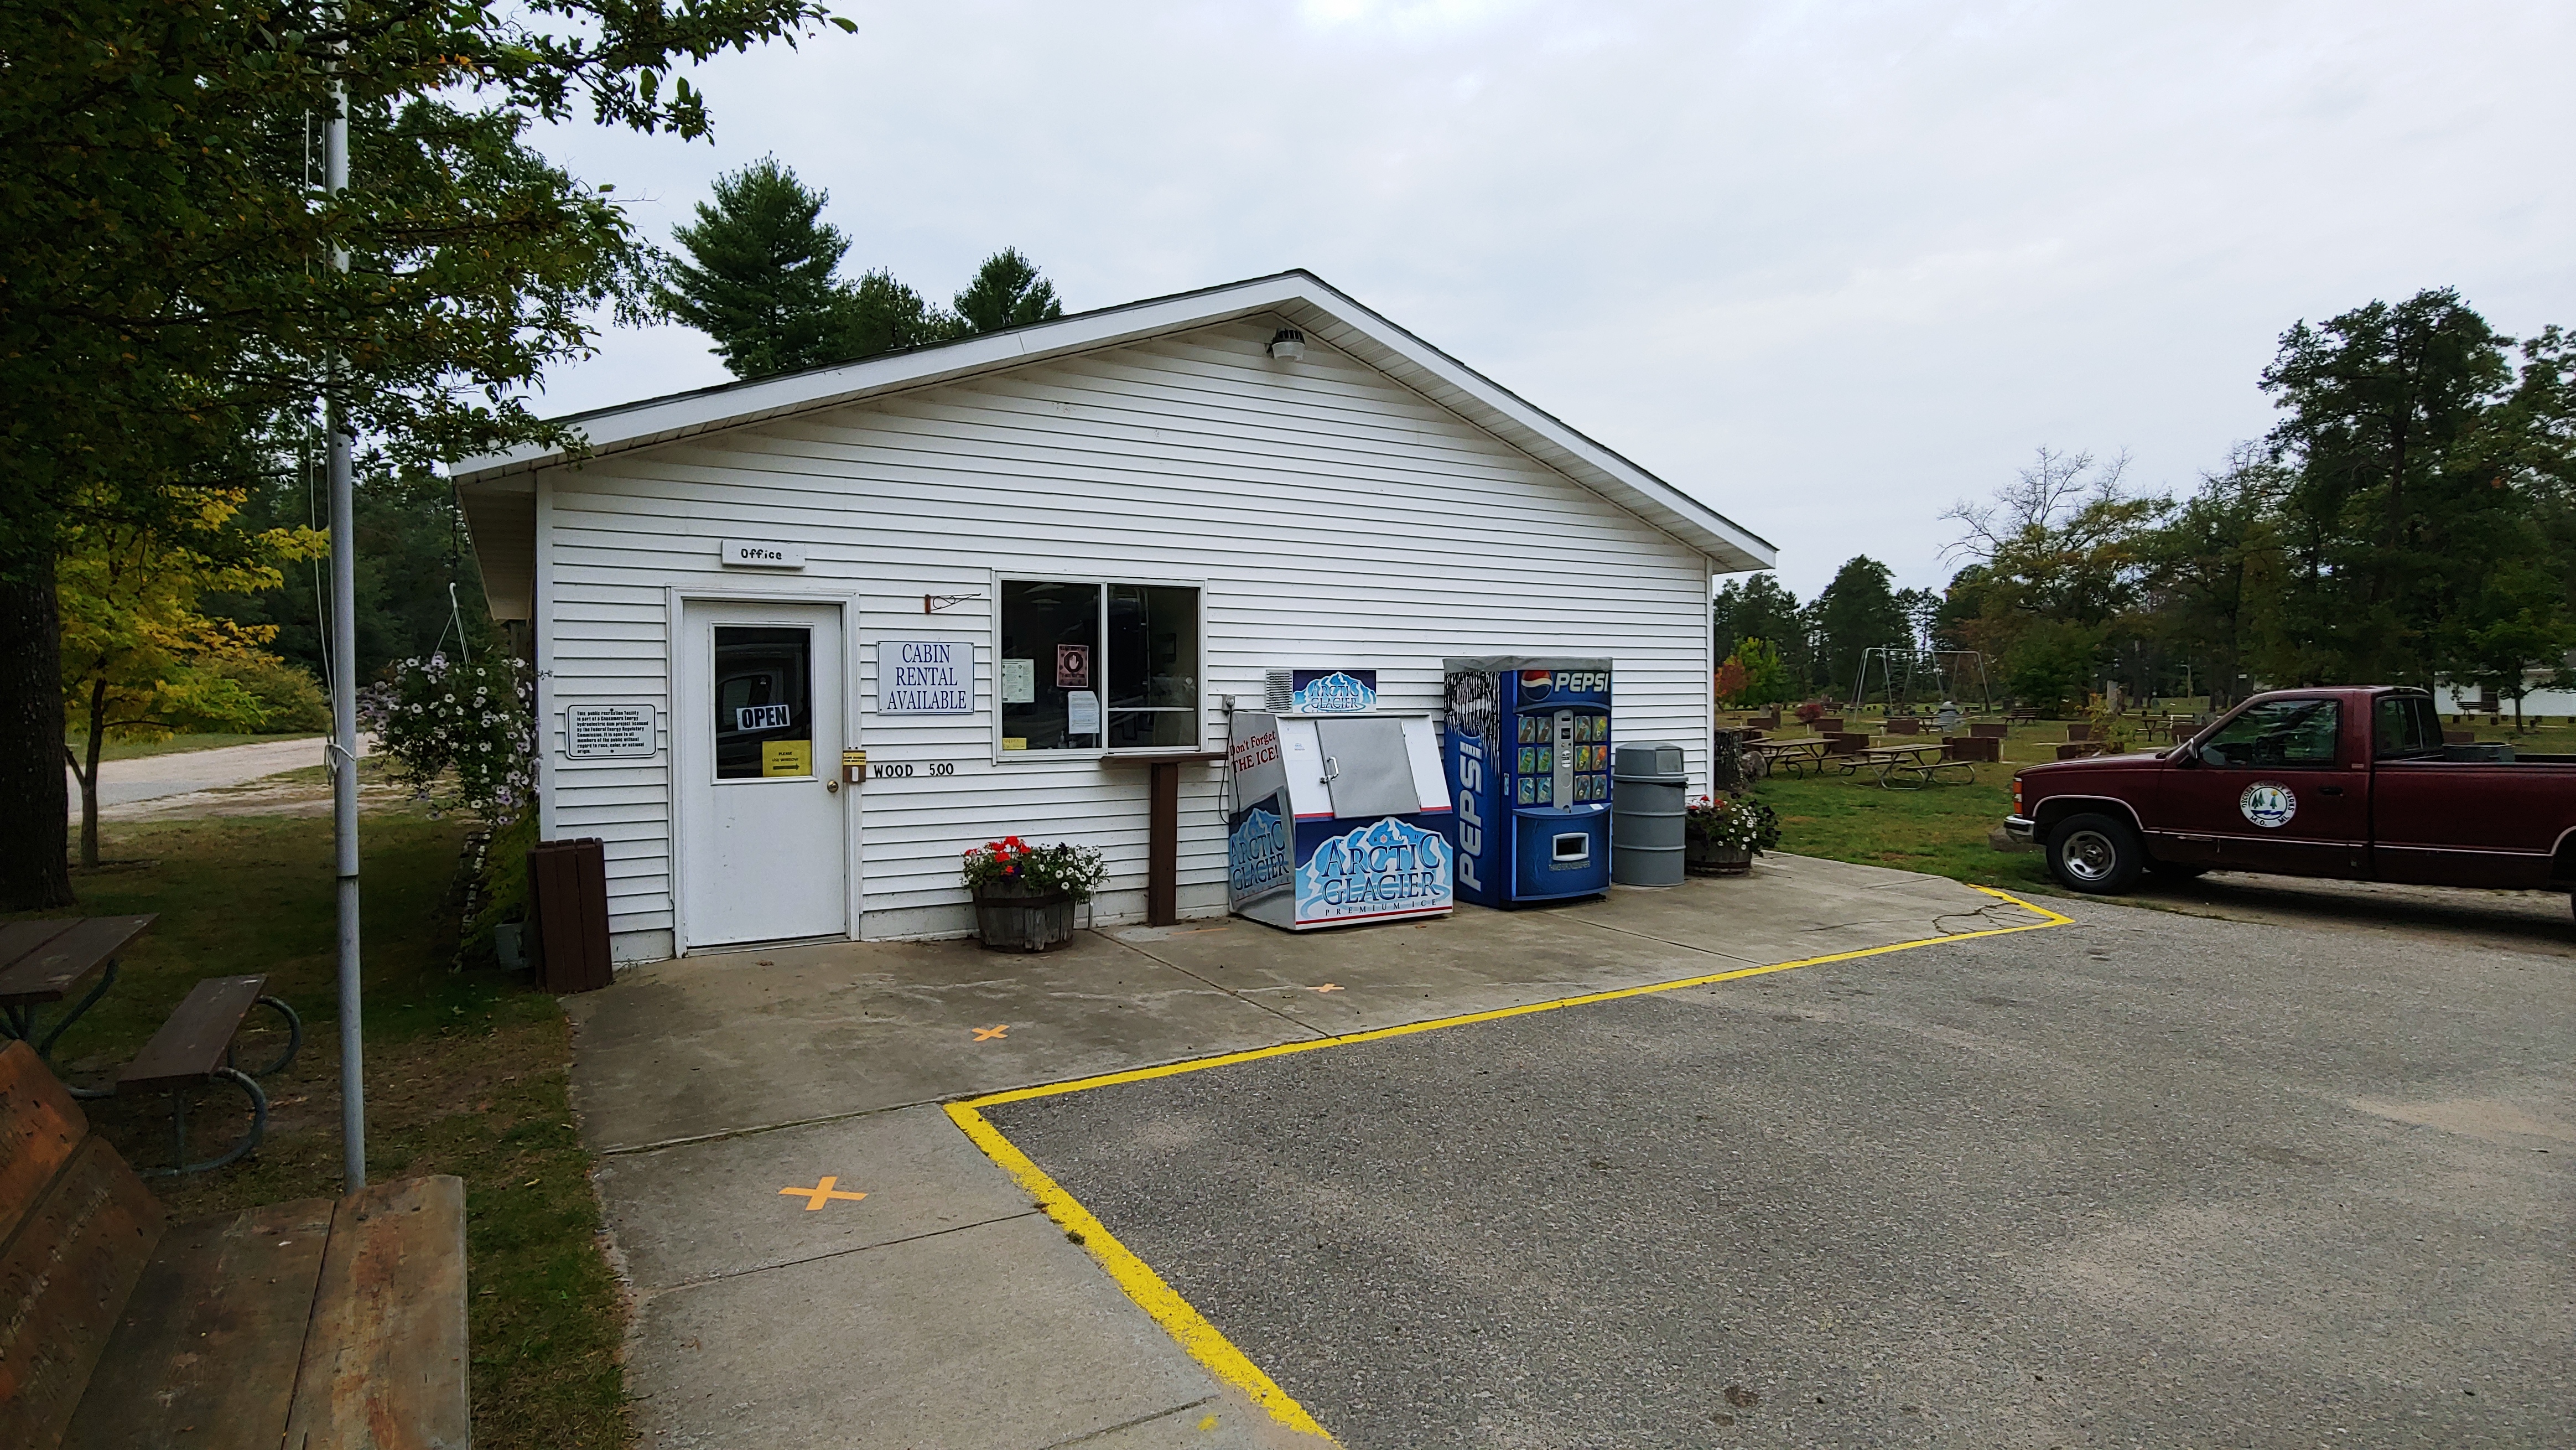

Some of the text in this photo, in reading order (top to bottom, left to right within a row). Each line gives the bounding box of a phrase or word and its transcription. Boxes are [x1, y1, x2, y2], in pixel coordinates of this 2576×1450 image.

[741, 548, 782, 560] Office
[902, 644, 951, 663] CABIN
[895, 667, 958, 686] RENTAL
[1554, 672, 1609, 692] PEPSI
[1310, 682, 1359, 697] ARCTIC
[886, 690, 967, 710] AVAILABLE
[1311, 697, 1359, 708] GLACIER
[741, 706, 787, 728] OPEN
[1229, 739, 1250, 757] Don't
[1250, 730, 1276, 749] Forget
[1231, 754, 1255, 773] THE
[1255, 744, 1279, 766] ICE!
[874, 764, 913, 778] WOOD
[2241, 786, 2256, 808] OSCODA
[1459, 740, 1483, 893] PEPSI
[1230, 820, 1285, 867] ARCTIC
[1339, 833, 1419, 845] CLEAR COLD
[1321, 833, 1440, 877] ARCTIC
[1233, 852, 1290, 891] GLACIER
[1322, 871, 1440, 905] GLACIER
[1325, 898, 1436, 916] PREMIUM ICE
